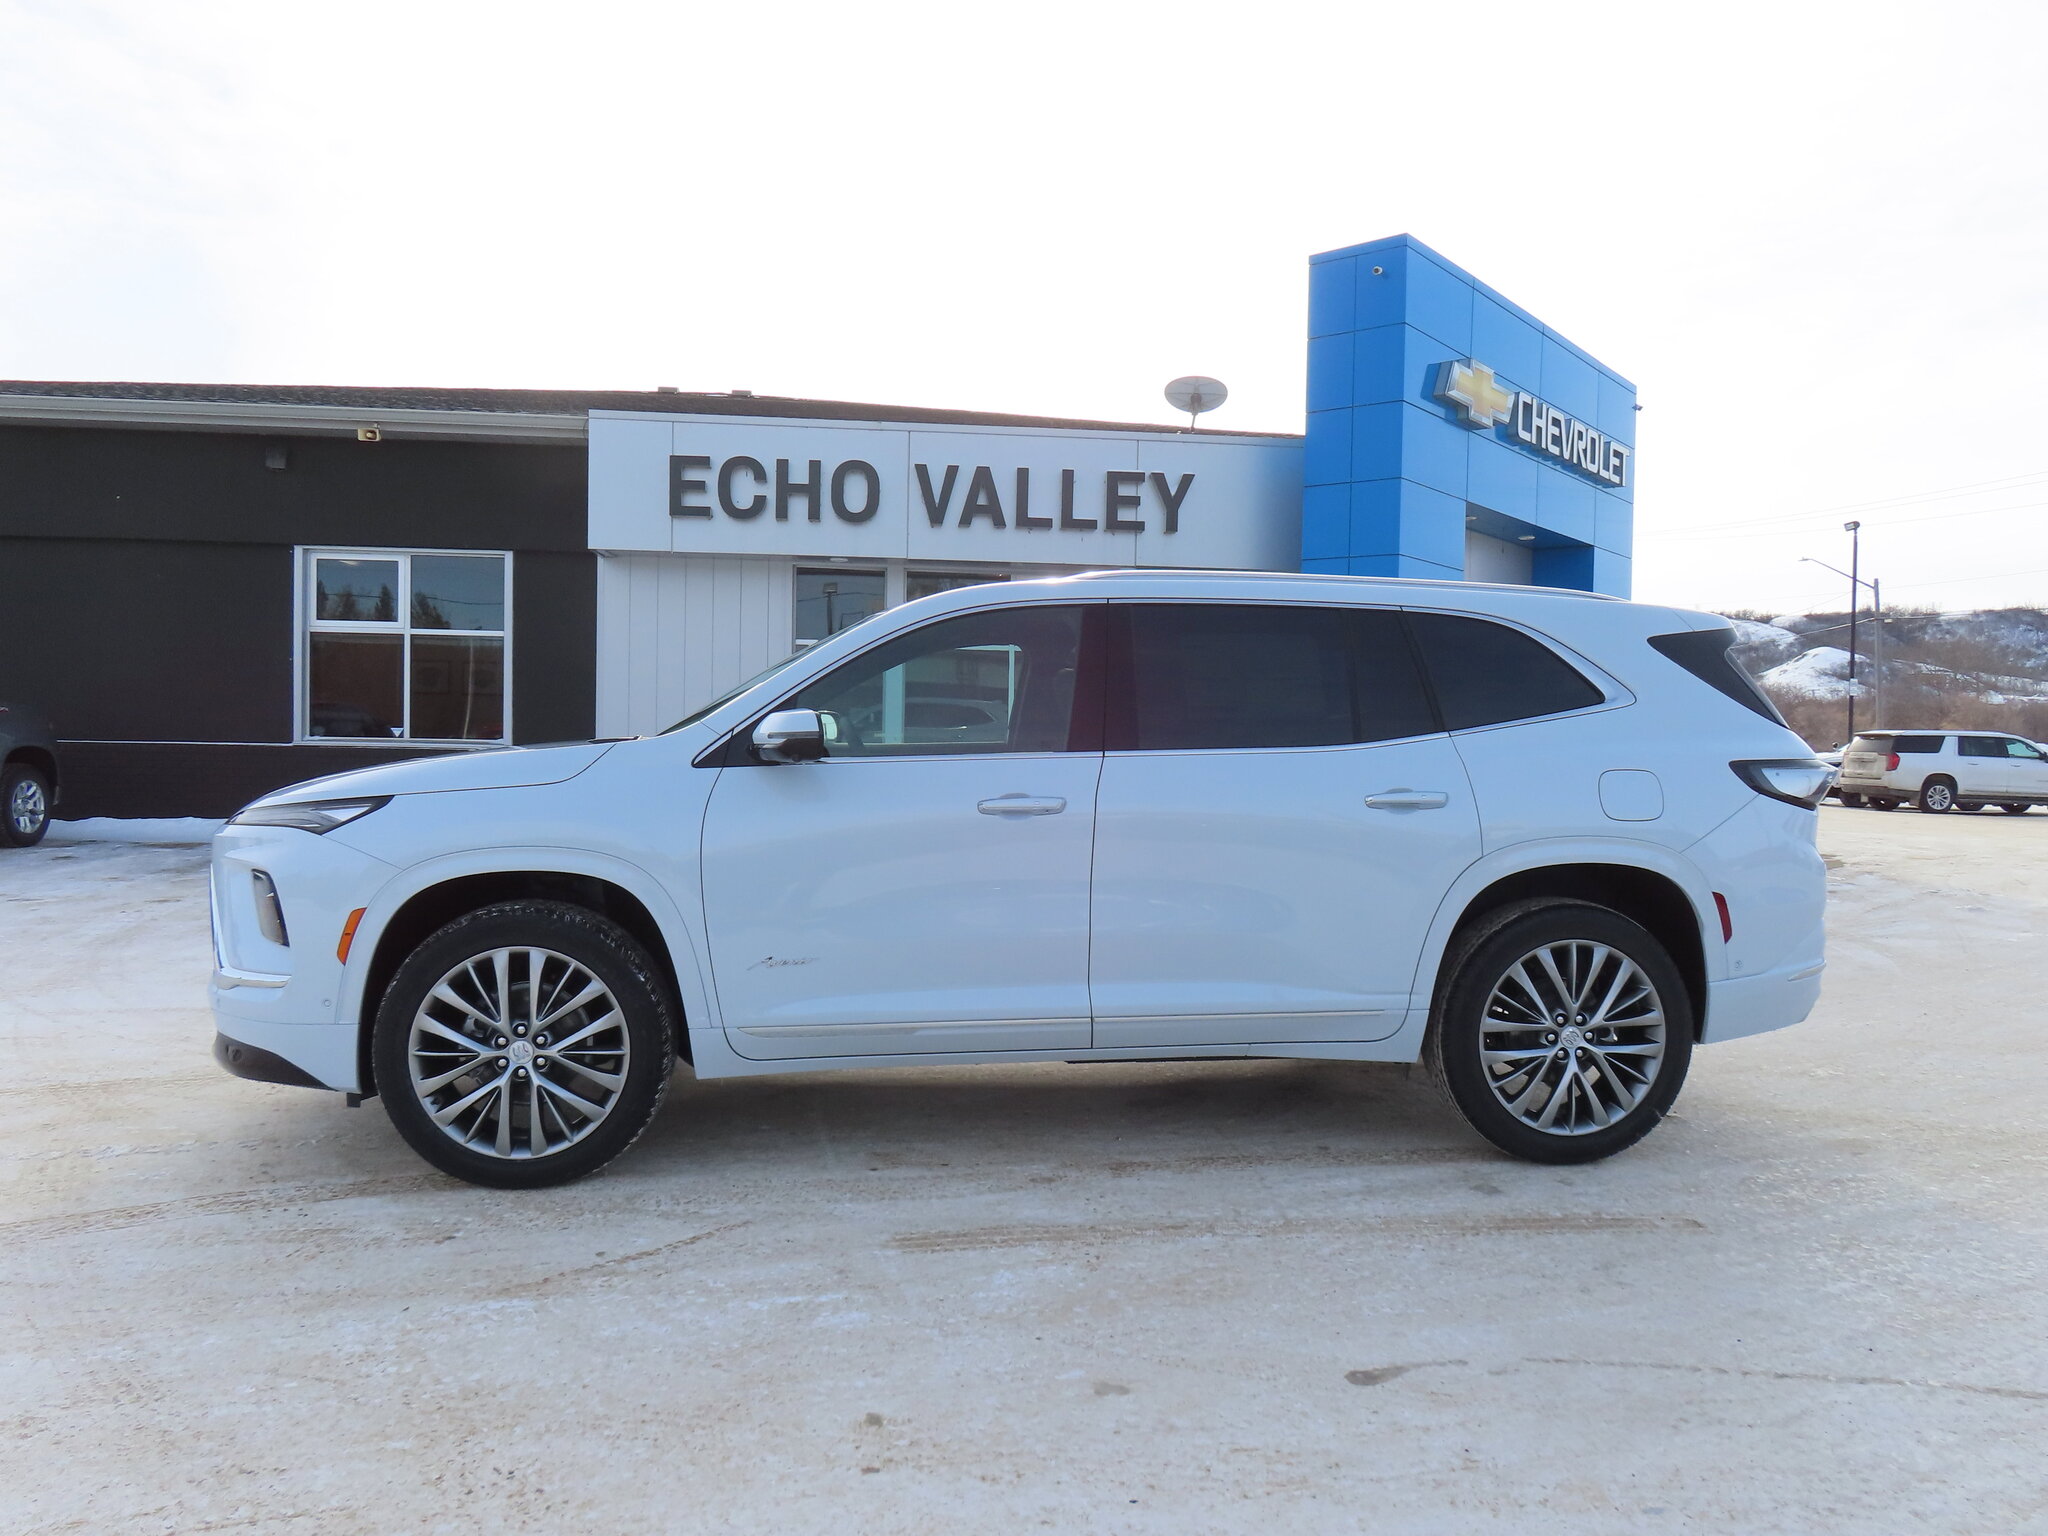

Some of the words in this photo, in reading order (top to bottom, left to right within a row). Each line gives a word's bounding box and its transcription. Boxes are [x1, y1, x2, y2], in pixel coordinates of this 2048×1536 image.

[1516, 391, 1630, 488] CHEVROLET
[669, 454, 880, 523] ECHO
[914, 463, 1196, 534] VALLEY
